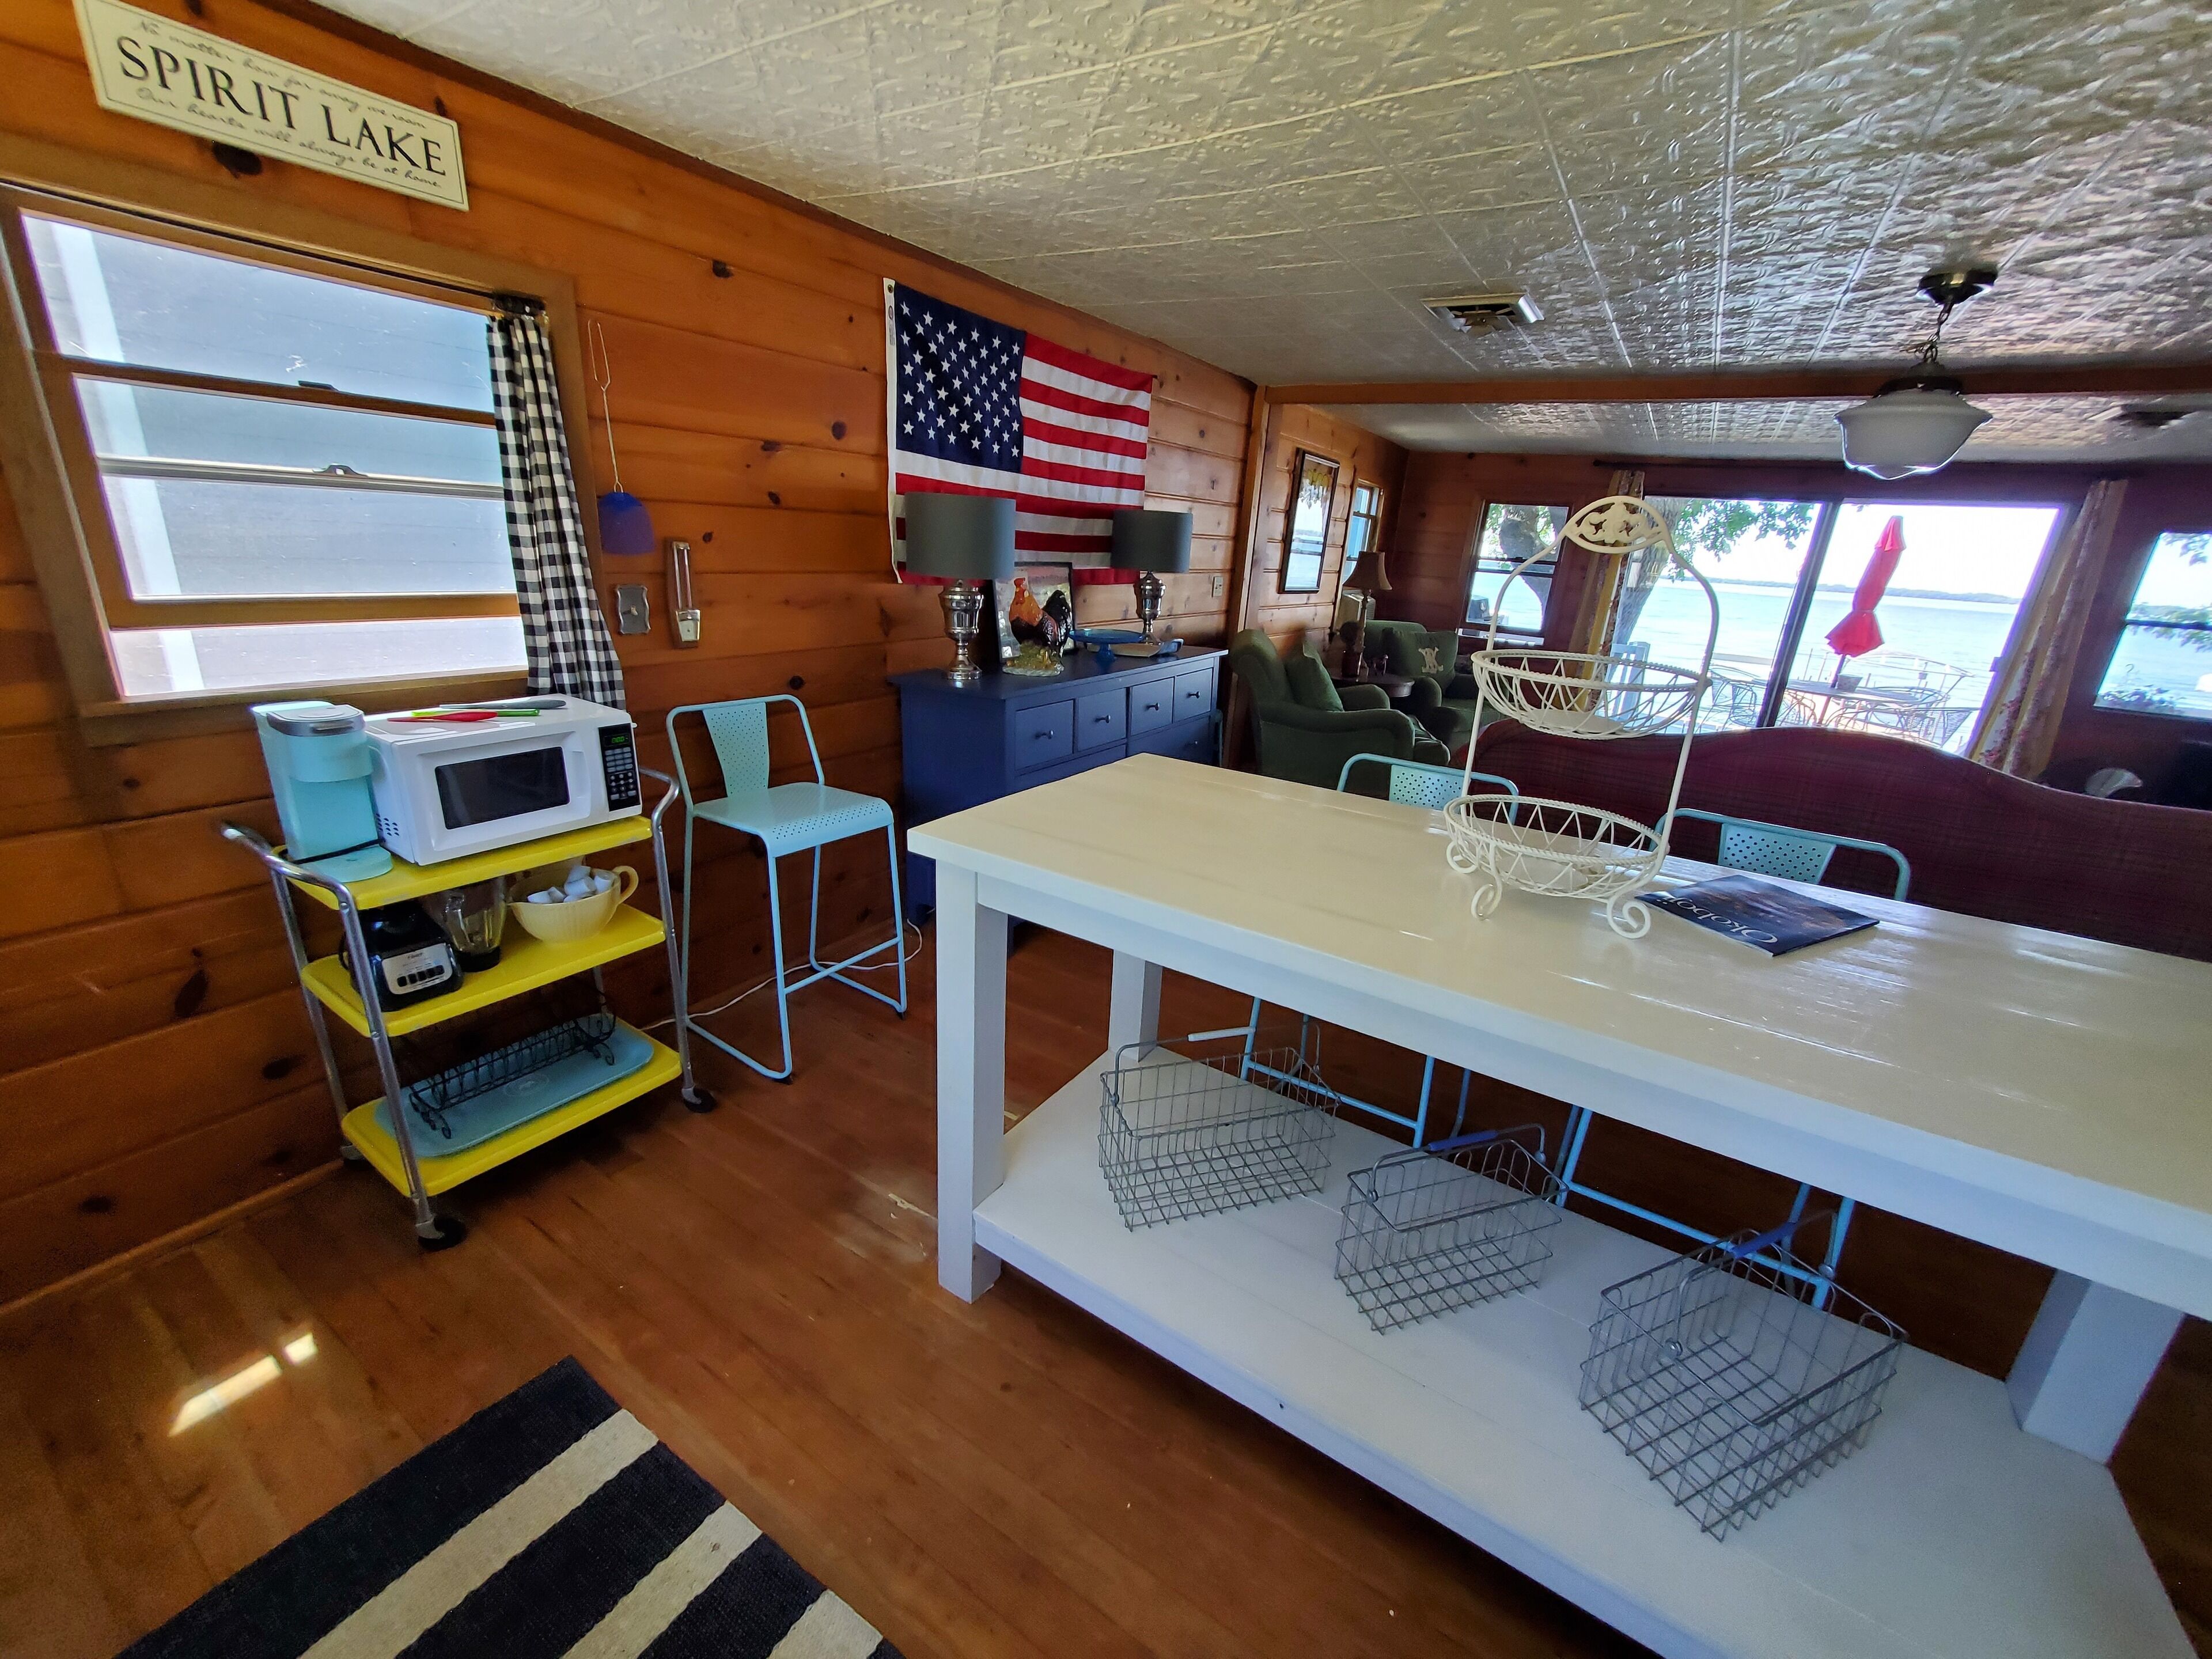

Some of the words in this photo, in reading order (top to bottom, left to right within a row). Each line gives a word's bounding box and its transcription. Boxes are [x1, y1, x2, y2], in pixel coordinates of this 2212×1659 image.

[117, 36, 300, 131] SPIRIT
[321, 104, 446, 176] LAKE
[243, 58, 279, 77] how
[320, 89, 359, 113] away
[299, 141, 356, 166] always
[362, 157, 377, 169] be
[384, 166, 399, 175] at
[1657, 897, 1778, 944] Okoboji
